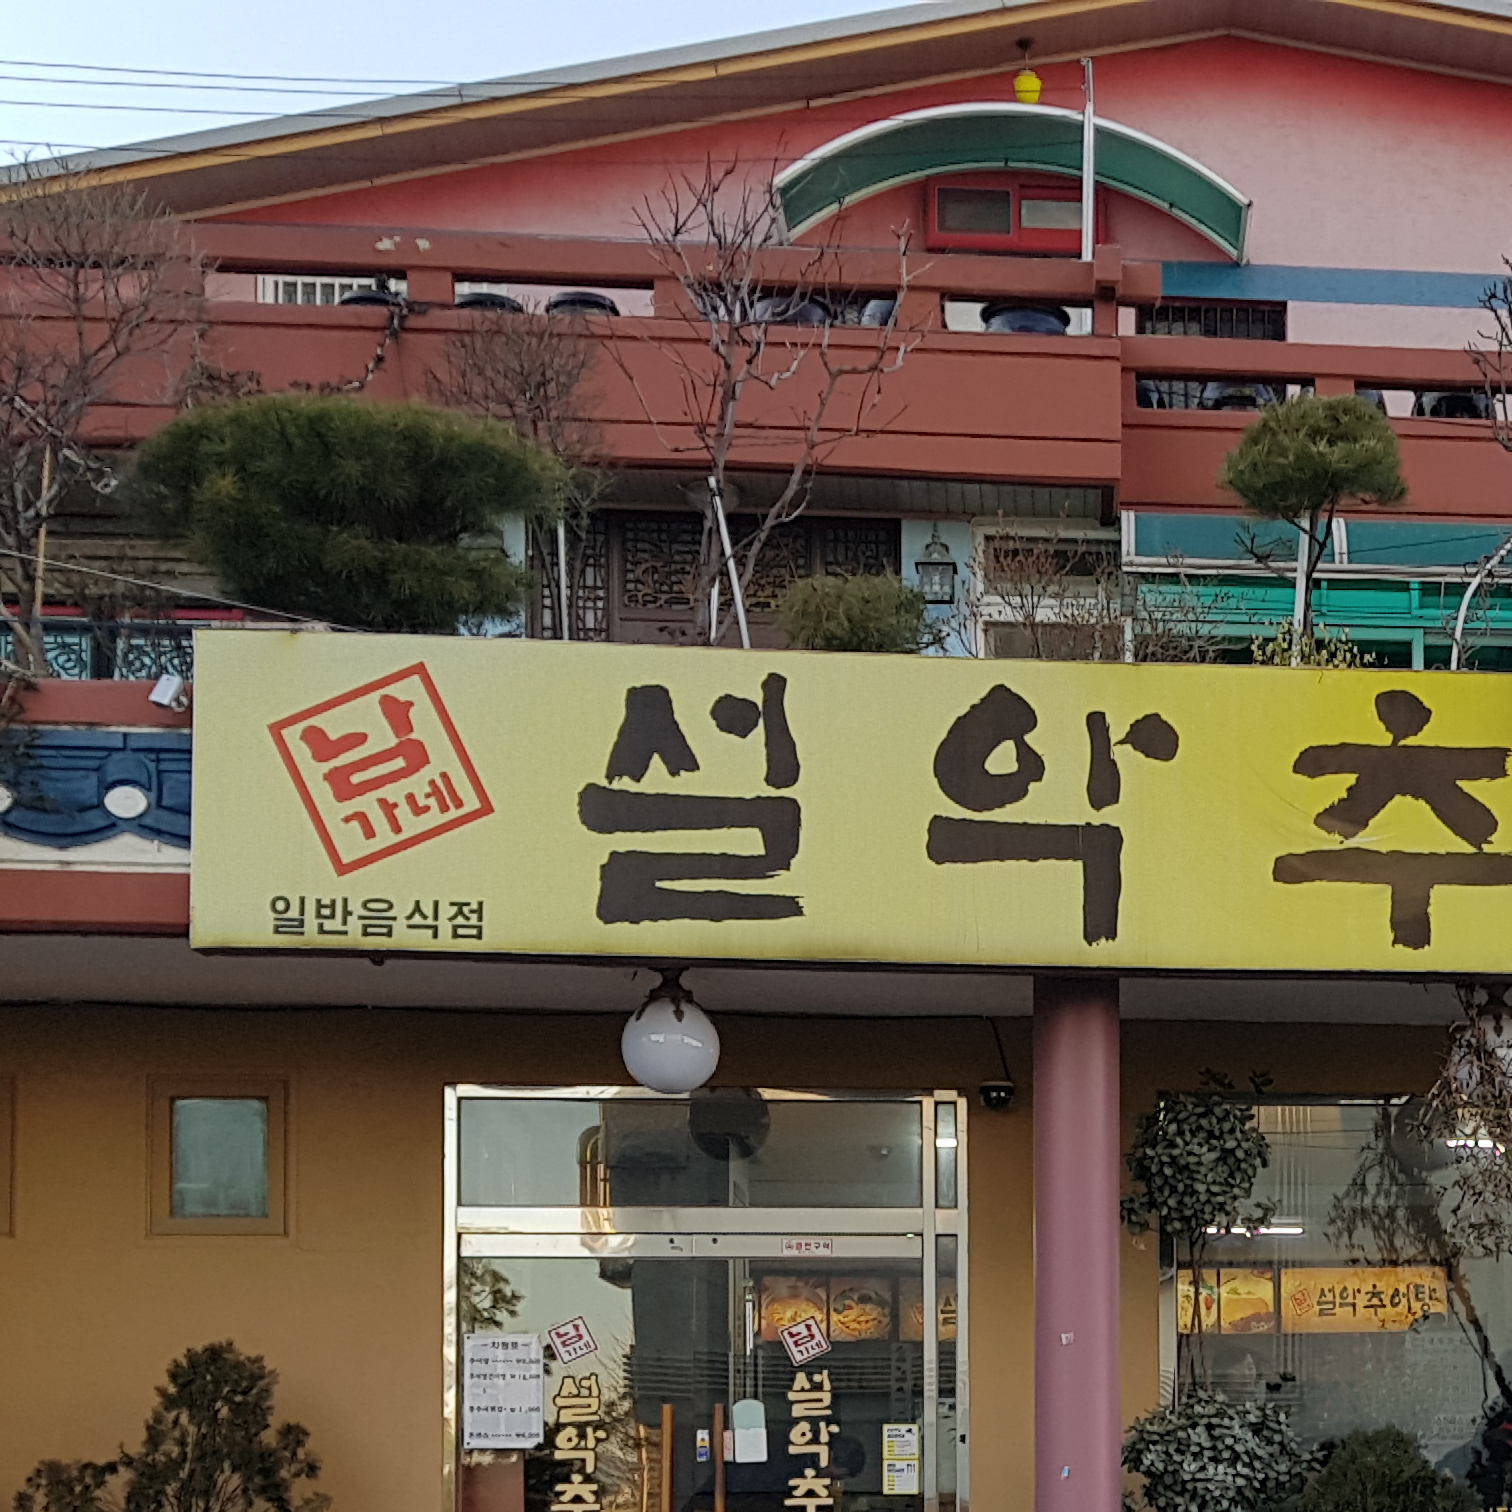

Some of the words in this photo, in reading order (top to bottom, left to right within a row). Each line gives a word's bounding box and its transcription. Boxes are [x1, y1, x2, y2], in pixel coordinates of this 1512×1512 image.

[300, 693, 431, 803] 남
[341, 770, 465, 841] 가네
[268, 895, 485, 941] 일반음식점
[1315, 1282, 1439, 1318] 설악추어탕
[554, 1323, 584, 1349] 남
[786, 1323, 816, 1349] 남
